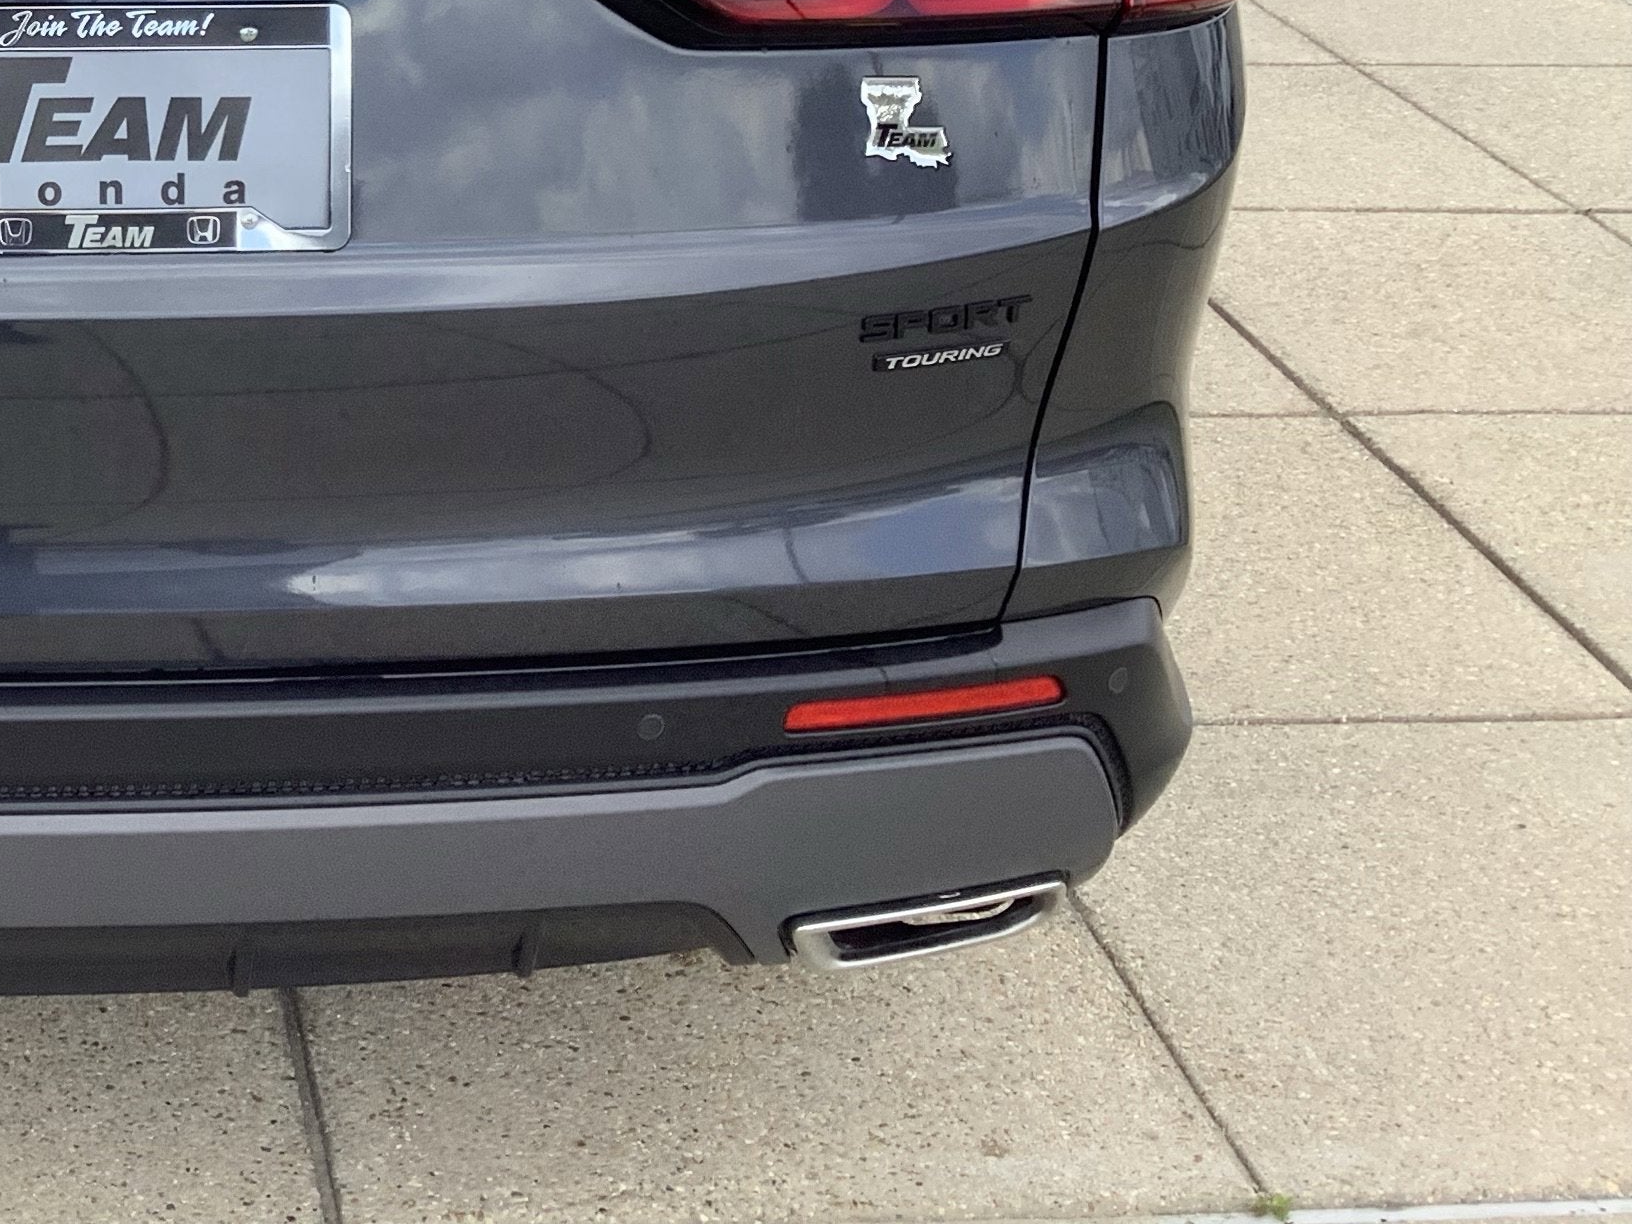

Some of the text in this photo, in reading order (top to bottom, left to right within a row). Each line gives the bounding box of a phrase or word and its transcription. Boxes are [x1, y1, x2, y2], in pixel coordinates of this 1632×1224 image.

[70, 10, 123, 39] The
[125, 10, 215, 39] Team!
[875, 123, 938, 148] TEAM
[64, 214, 155, 249] TEAM
[859, 294, 1033, 343] SPORT
[886, 343, 1004, 370] TOURING
